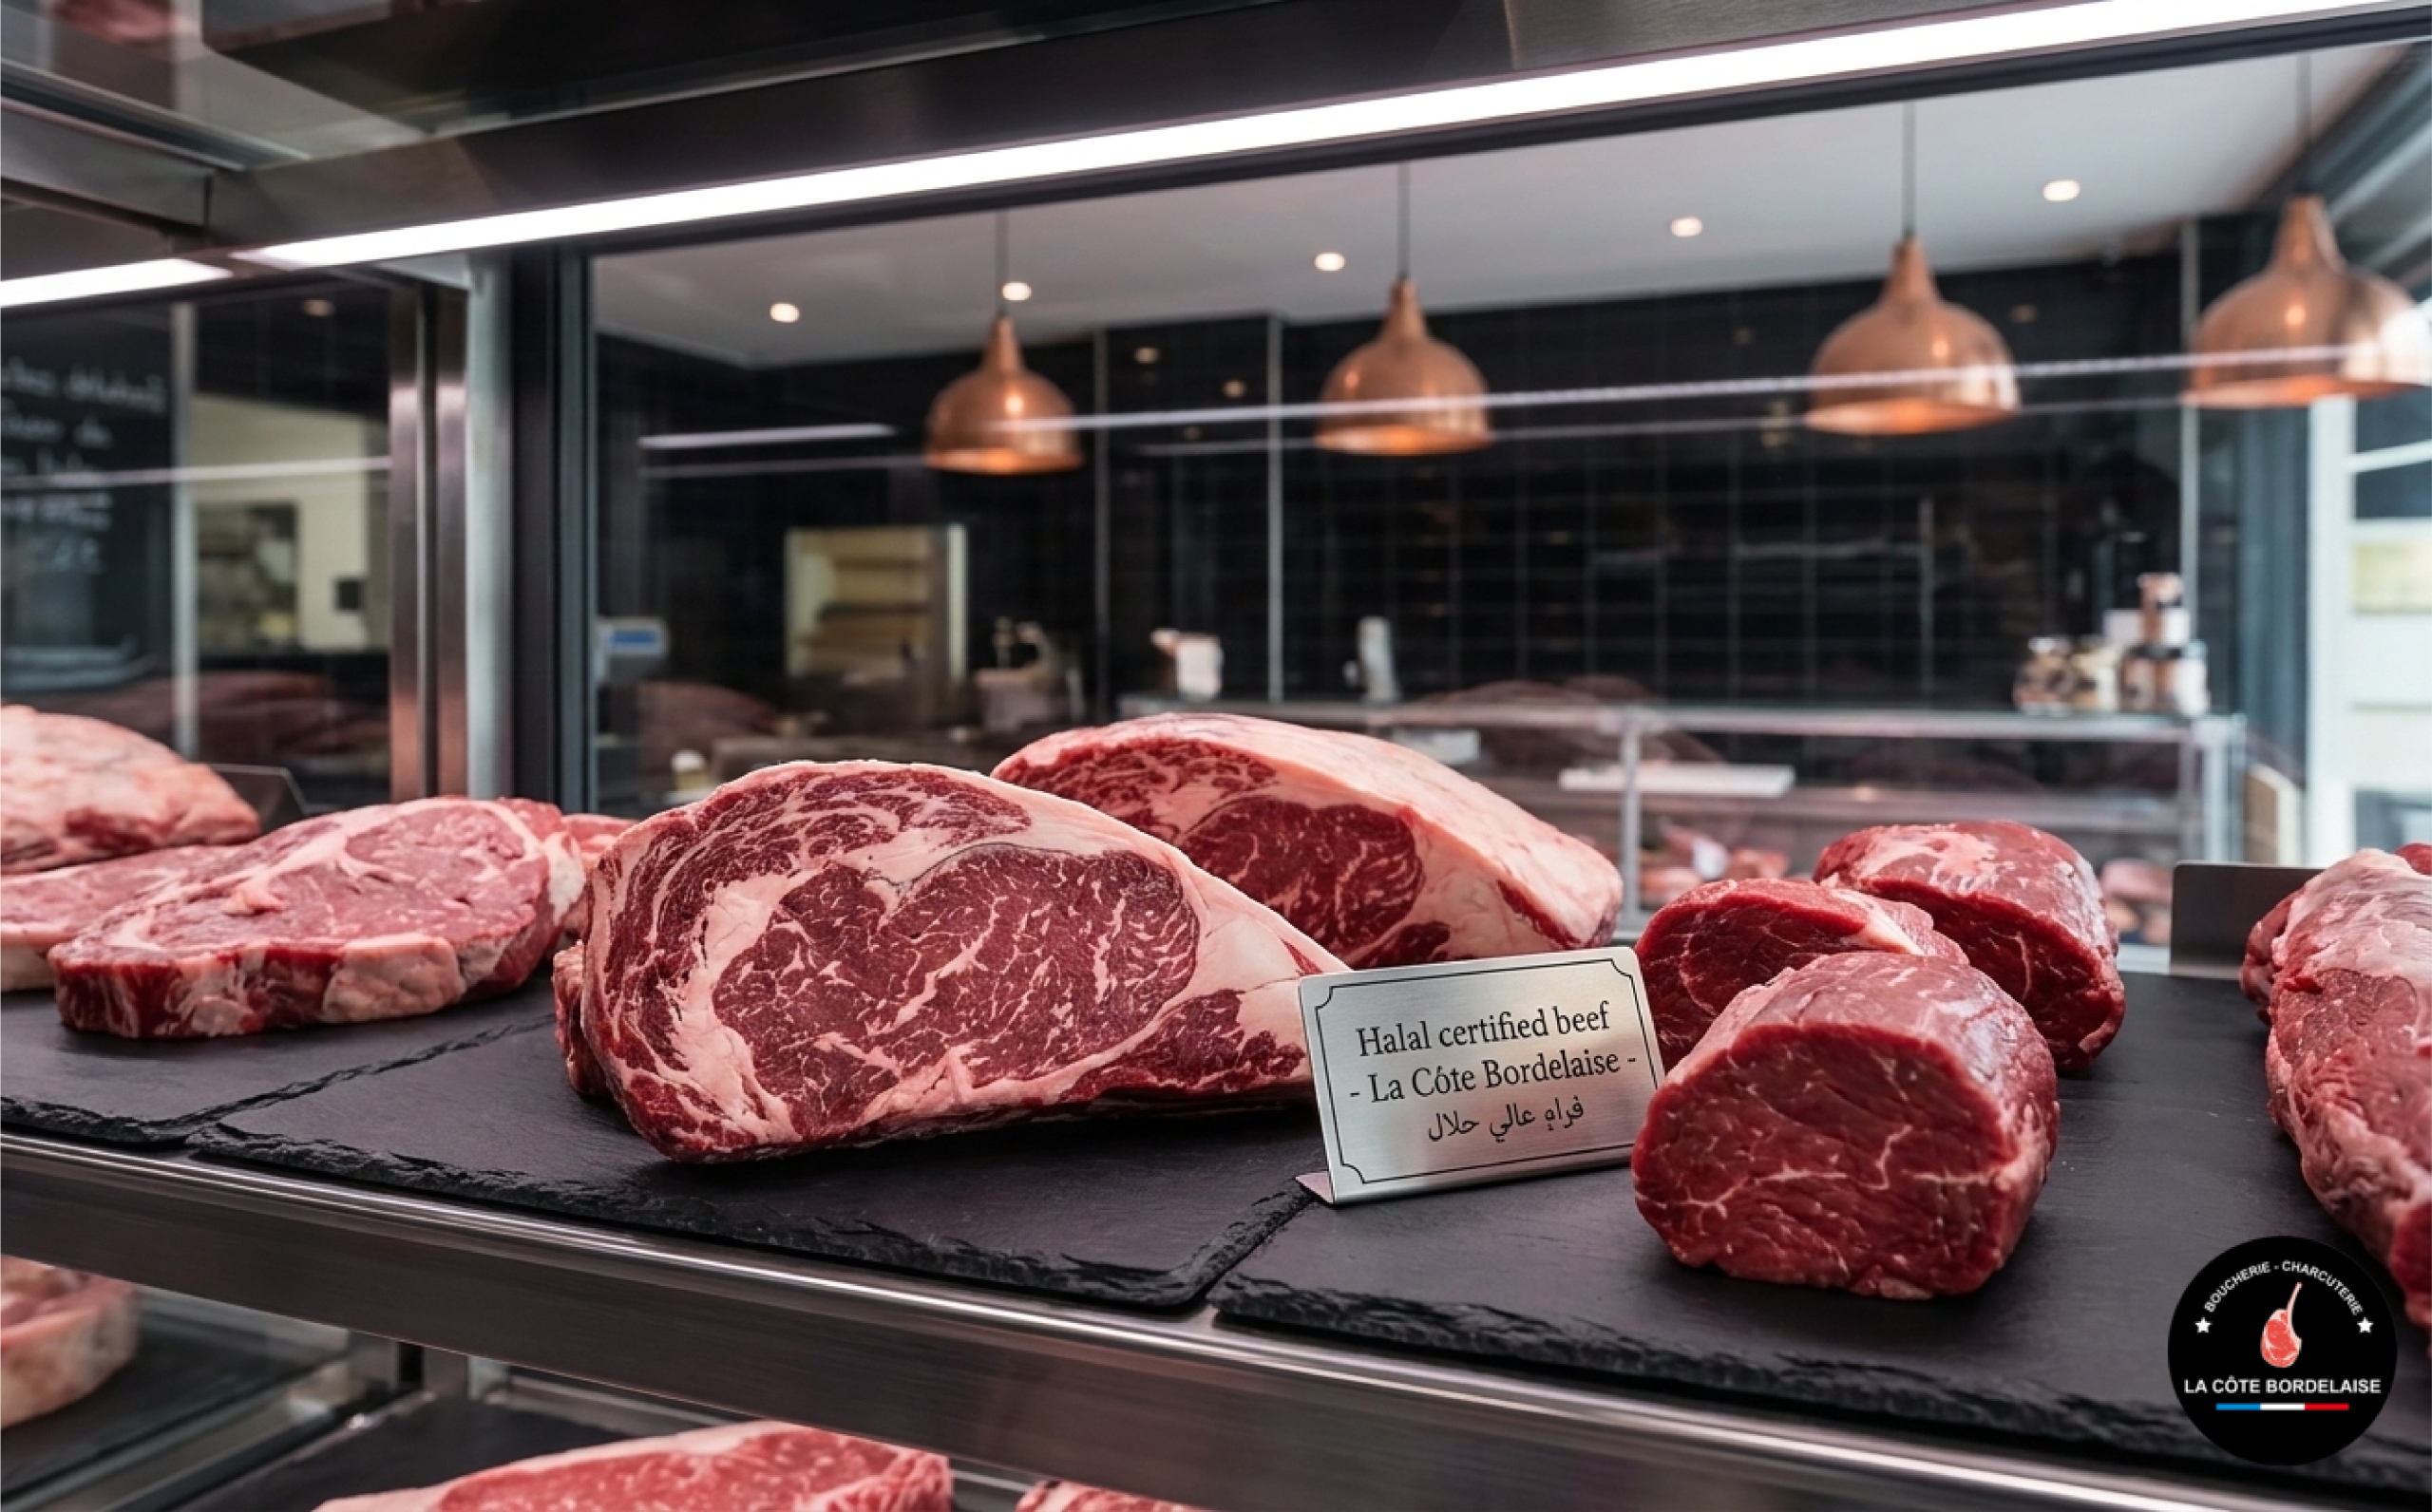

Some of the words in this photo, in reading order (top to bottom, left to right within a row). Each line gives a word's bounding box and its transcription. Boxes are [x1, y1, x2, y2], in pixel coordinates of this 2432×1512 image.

[1356, 1022, 1433, 1057] Halal
[1438, 1010, 1550, 1048] certified
[1551, 1000, 1610, 1035] beef
[1368, 1073, 1405, 1103] La
[1481, 1049, 1622, 1089] Bordelaise
[1428, 1109, 1480, 1143] حلال
